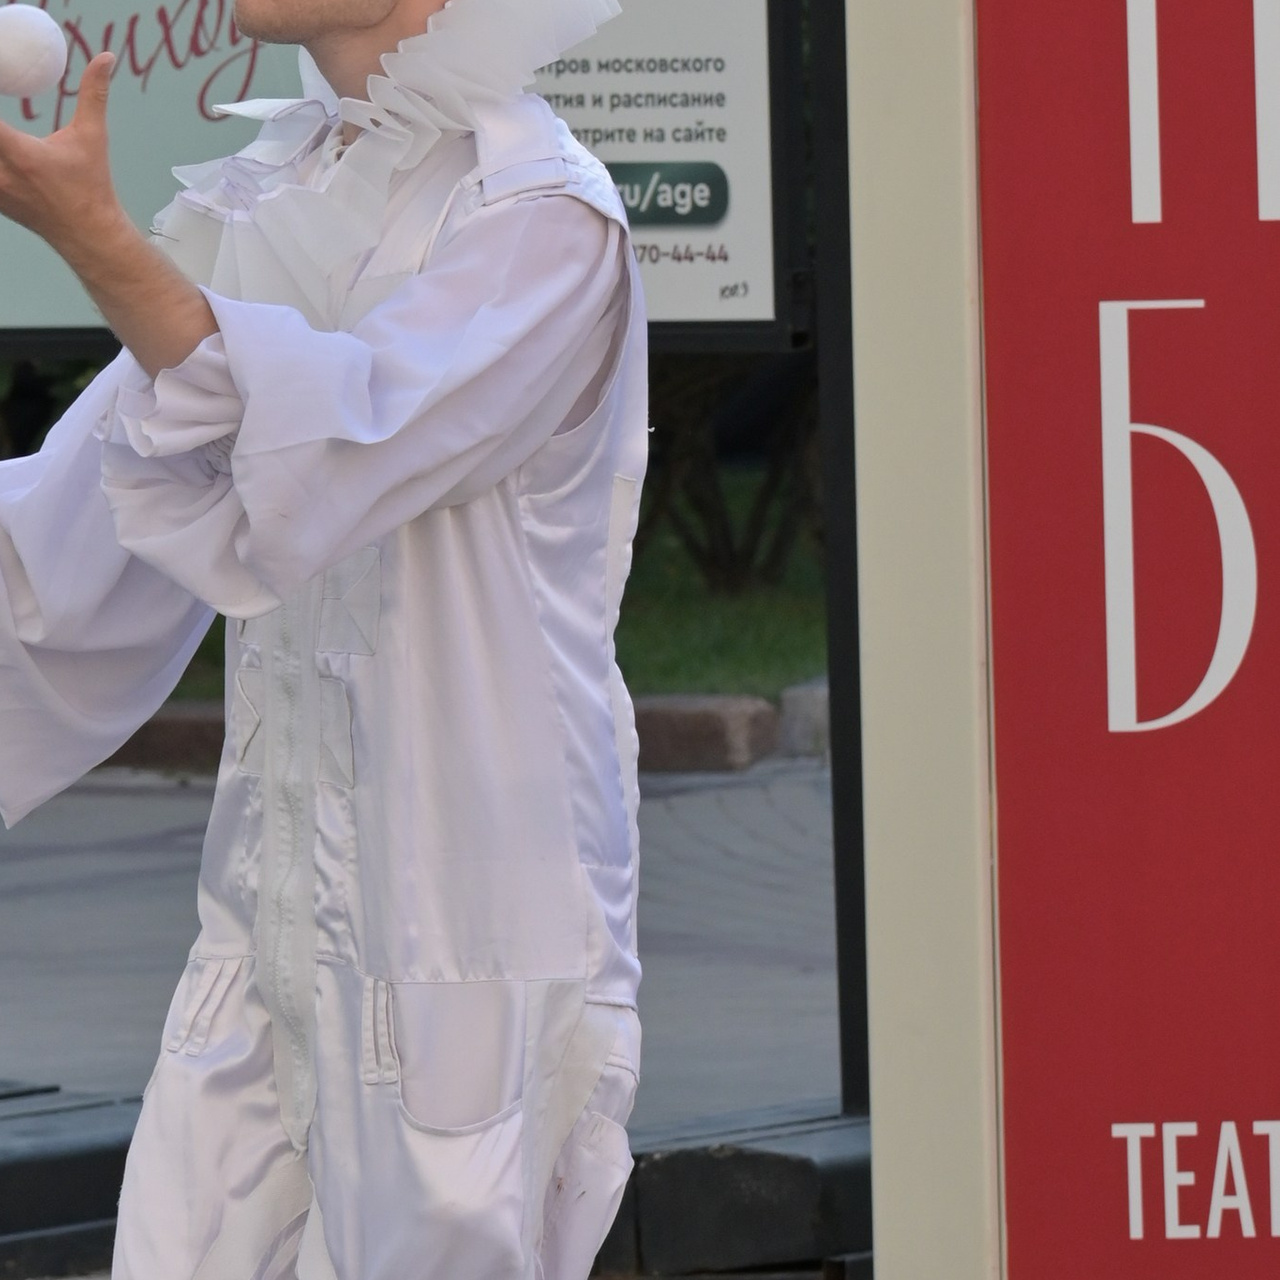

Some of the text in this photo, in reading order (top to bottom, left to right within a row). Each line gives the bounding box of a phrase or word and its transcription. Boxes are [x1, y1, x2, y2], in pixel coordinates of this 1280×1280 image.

[597, 56, 726, 73] московского
[592, 93, 603, 108] и
[609, 91, 726, 111] расписание
[643, 128, 666, 143] на
[671, 120, 727, 143] сайте
[633, 244, 729, 264] 70-44-44
[1111, 1120, 1280, 1240] ТЕАТ
